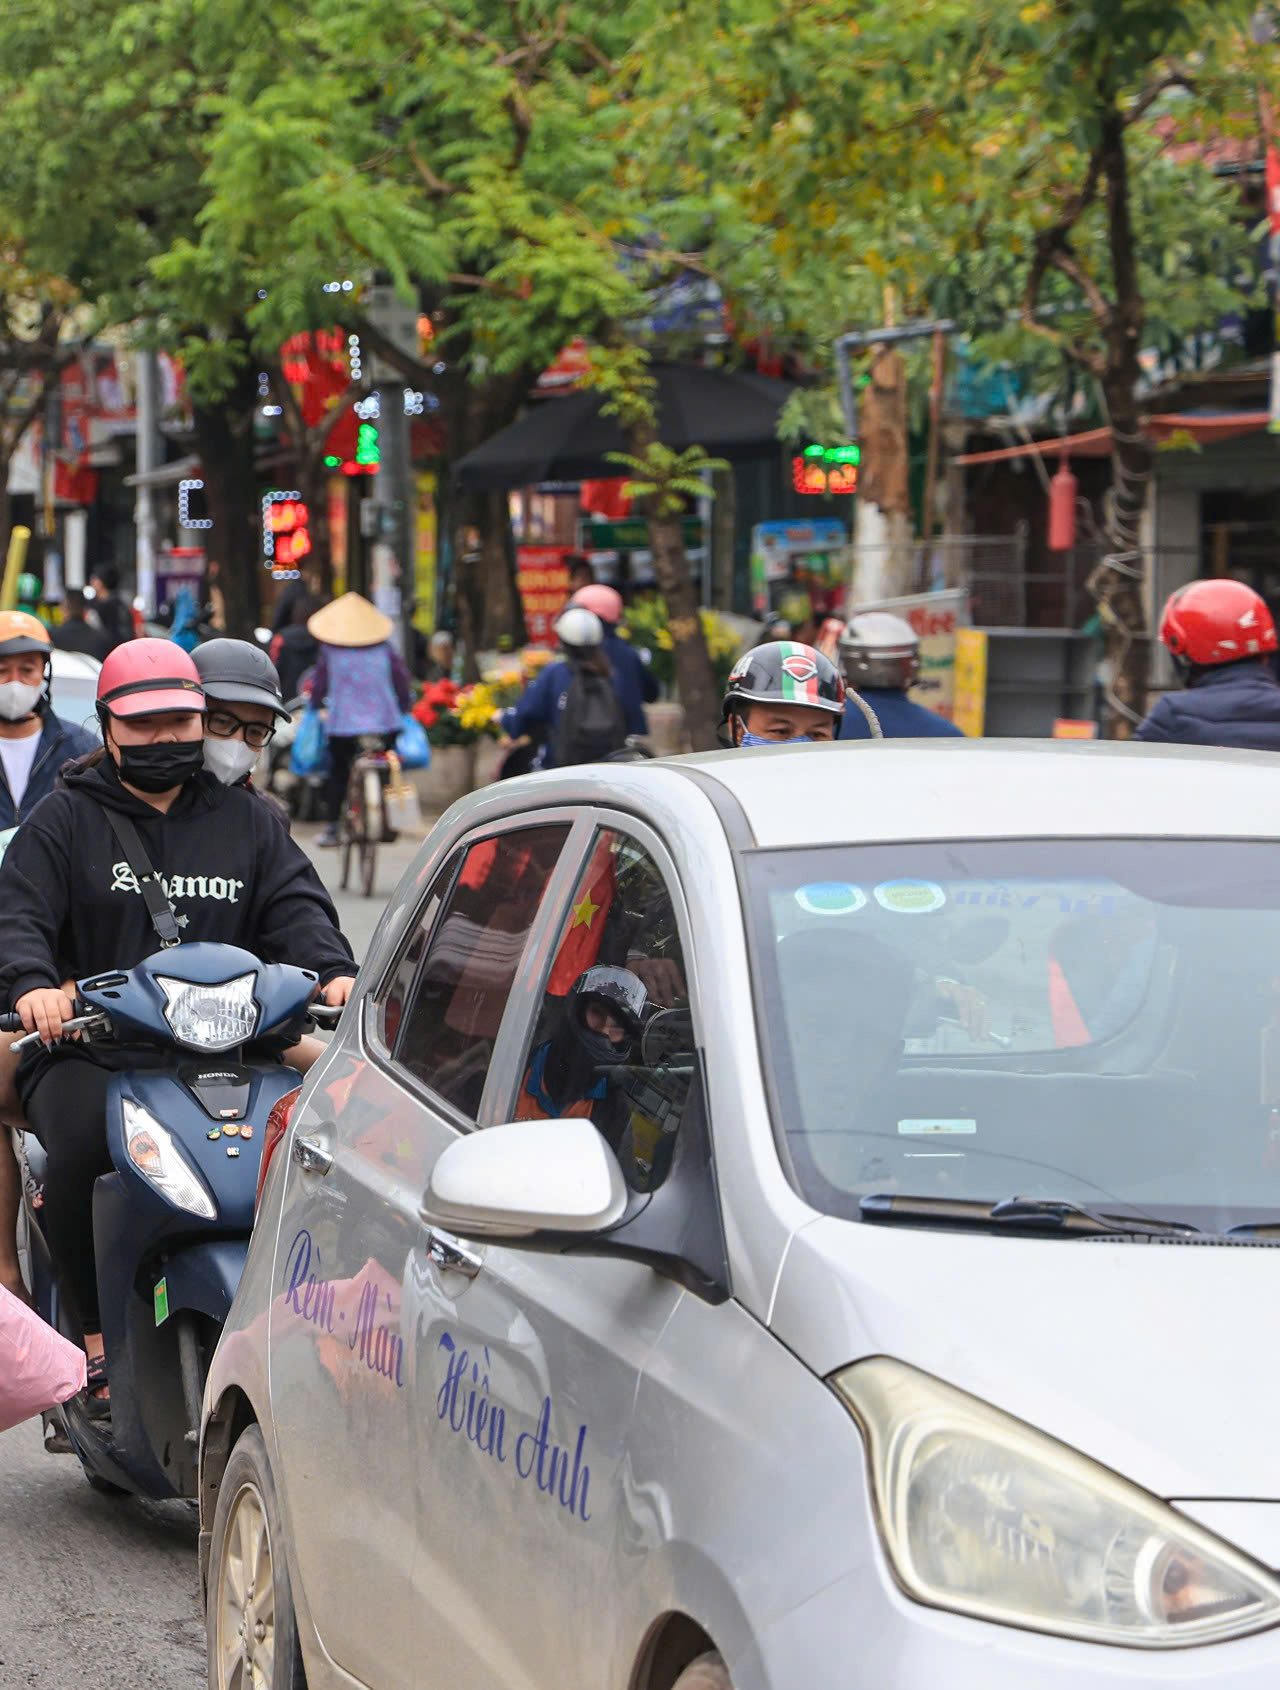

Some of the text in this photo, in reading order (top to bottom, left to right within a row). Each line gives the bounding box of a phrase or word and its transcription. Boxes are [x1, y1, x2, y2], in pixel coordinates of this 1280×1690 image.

[110, 861, 245, 905] Aanor
[436, 1331, 507, 1463] Hiền
[515, 1395, 592, 1522] Anh
